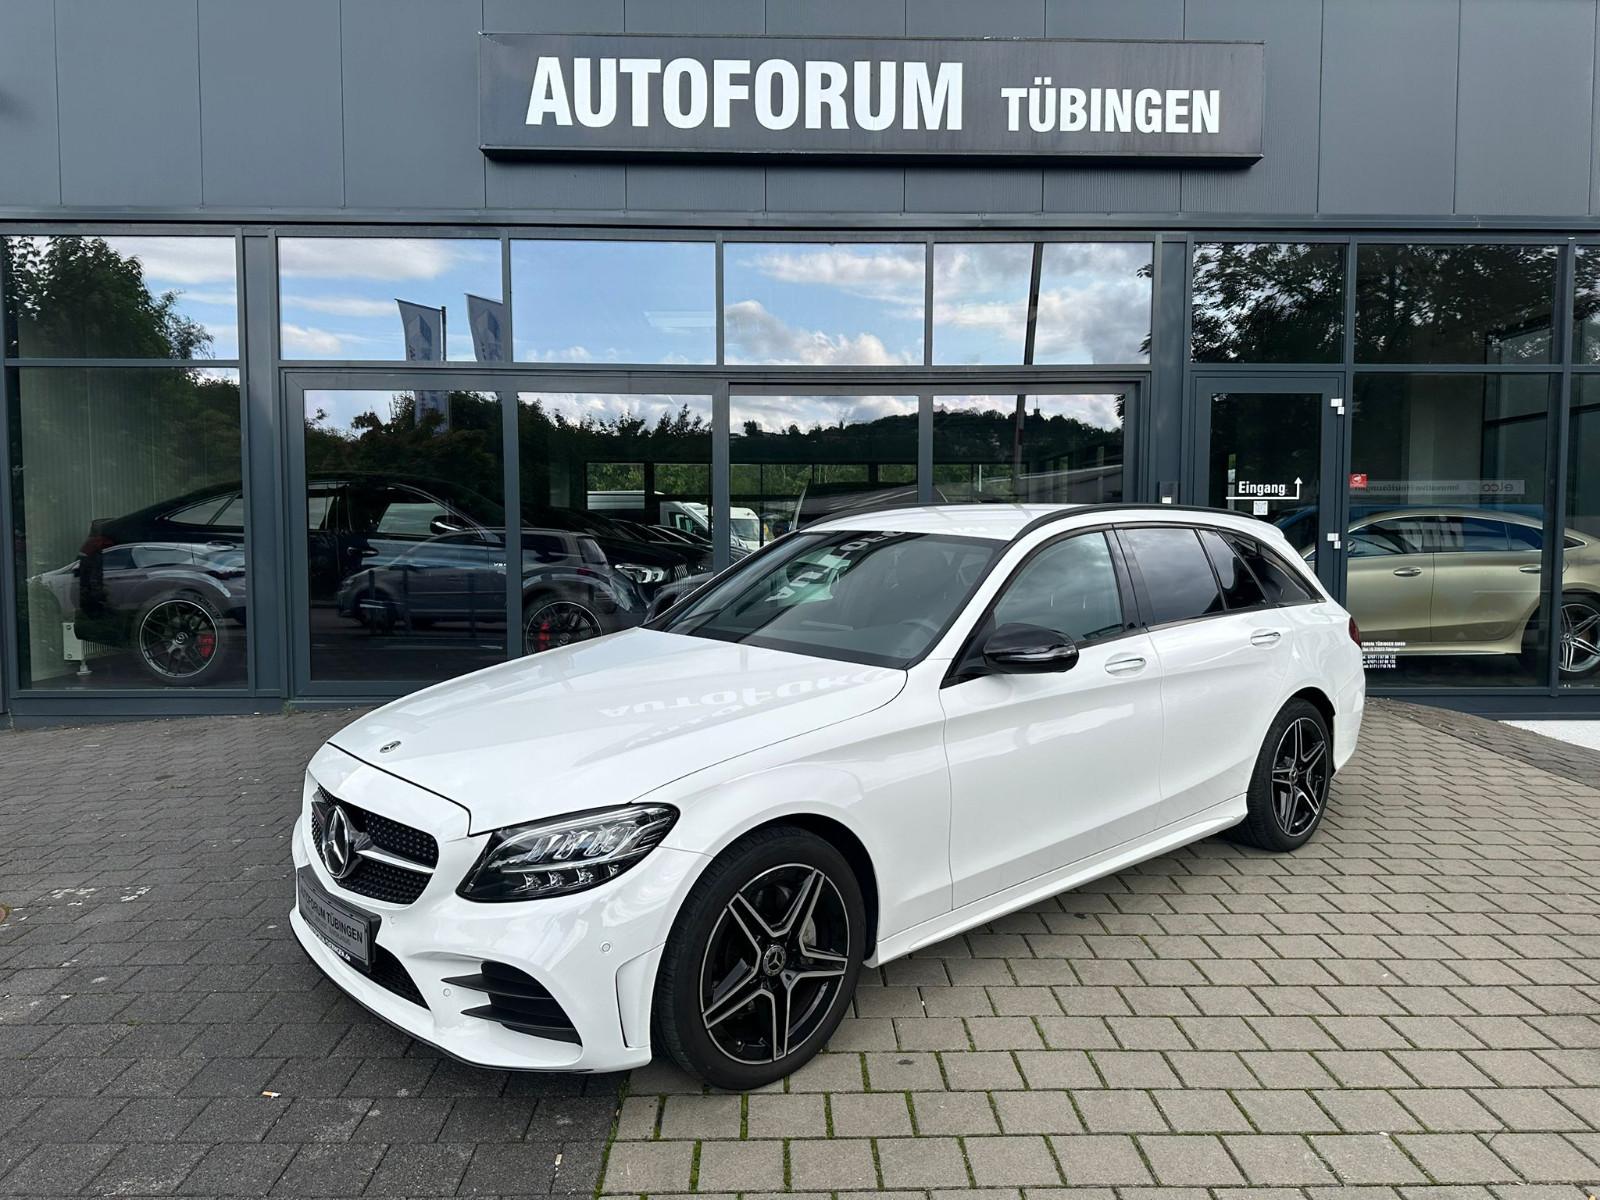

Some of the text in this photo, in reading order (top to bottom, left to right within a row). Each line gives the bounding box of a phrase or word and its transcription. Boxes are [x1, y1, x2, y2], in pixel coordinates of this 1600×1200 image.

[526, 57, 1219, 133] AUTOFORUM TÜBINGEN
[1239, 481, 1285, 496] Eingang
[326, 911, 363, 945] TÜBINGEN
